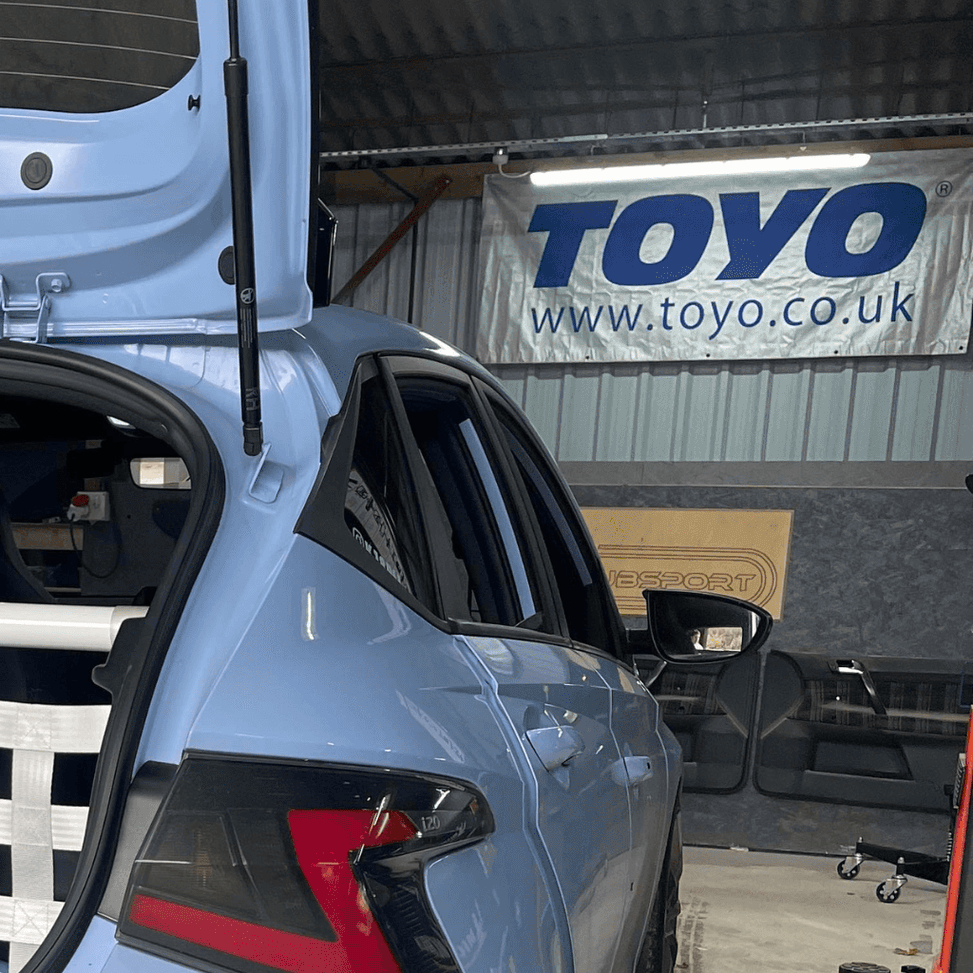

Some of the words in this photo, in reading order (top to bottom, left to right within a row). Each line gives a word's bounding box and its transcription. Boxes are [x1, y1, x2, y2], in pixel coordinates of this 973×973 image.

[527, 181, 927, 288] TOYO
[532, 281, 914, 340] www.toyo.co.uk
[421, 815, 441, 832] i20
